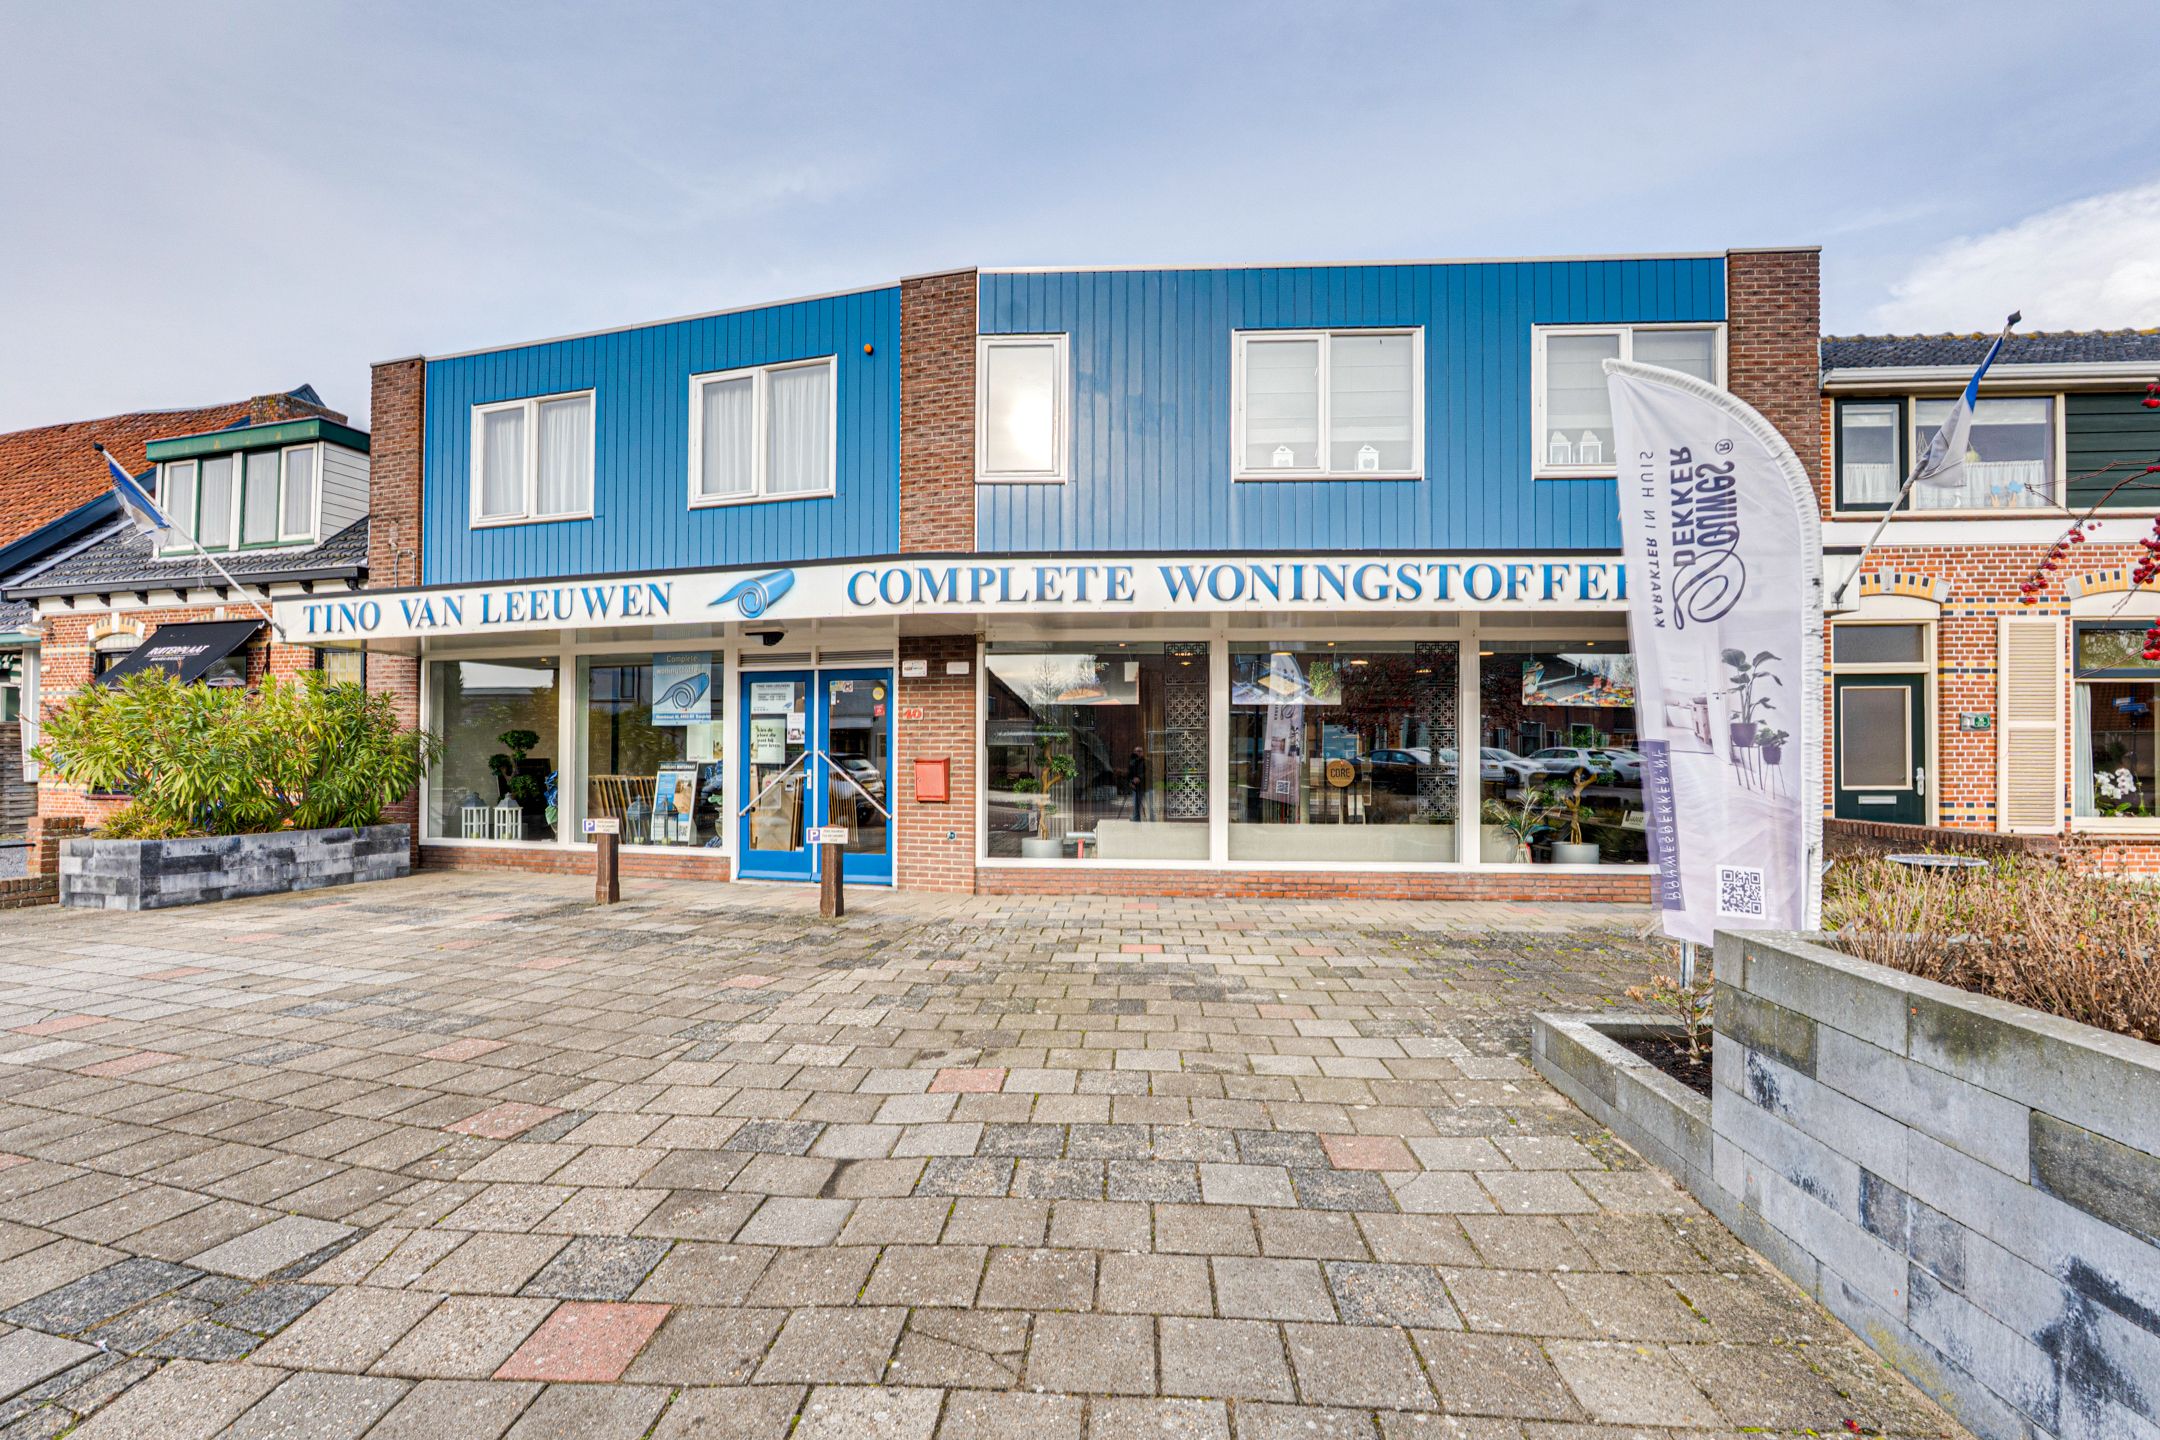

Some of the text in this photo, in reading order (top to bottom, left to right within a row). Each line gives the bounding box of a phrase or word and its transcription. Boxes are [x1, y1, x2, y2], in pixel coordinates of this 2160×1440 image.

[846, 565, 1136, 605] COMPLETE
[302, 582, 673, 635] TINO VAN LEEUWEN
[1330, 768, 1350, 777] CORE
